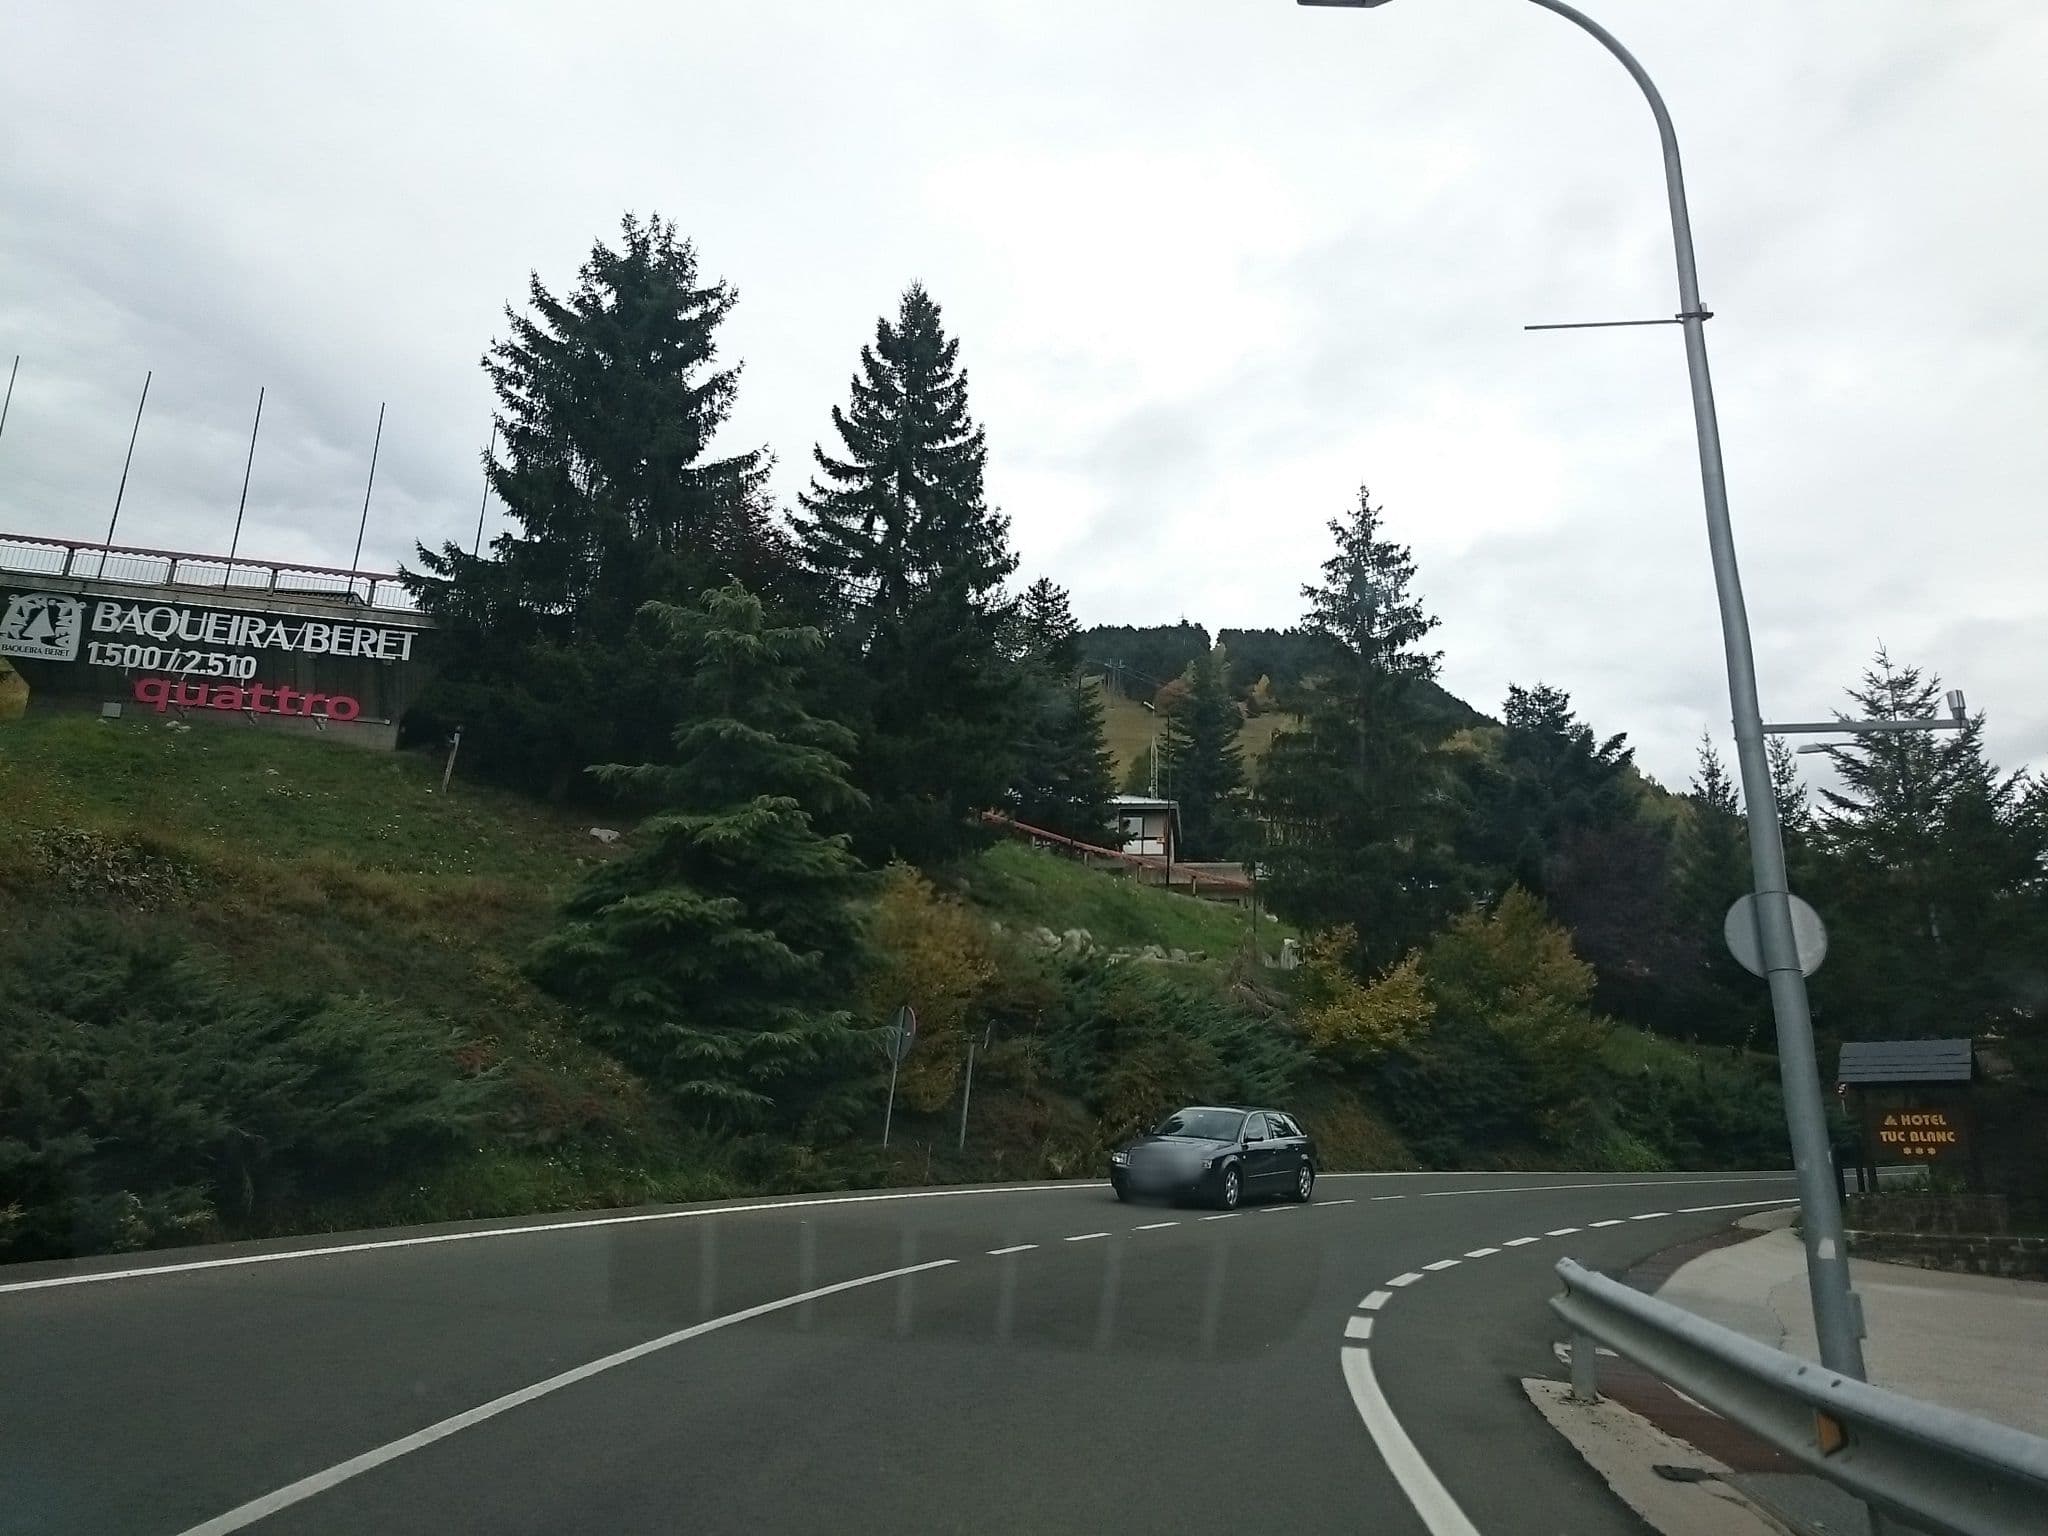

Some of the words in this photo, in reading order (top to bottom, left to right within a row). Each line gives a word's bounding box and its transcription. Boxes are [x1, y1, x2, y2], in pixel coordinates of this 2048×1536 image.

[91, 602, 418, 661] BAQUEIRA/BERET
[45, 648, 70, 657] BERET
[134, 678, 360, 721] quattro
[1901, 1114, 1946, 1126] HOTEL
[1880, 1131, 1906, 1142] TUC
[1910, 1131, 1955, 1143] BLANC
